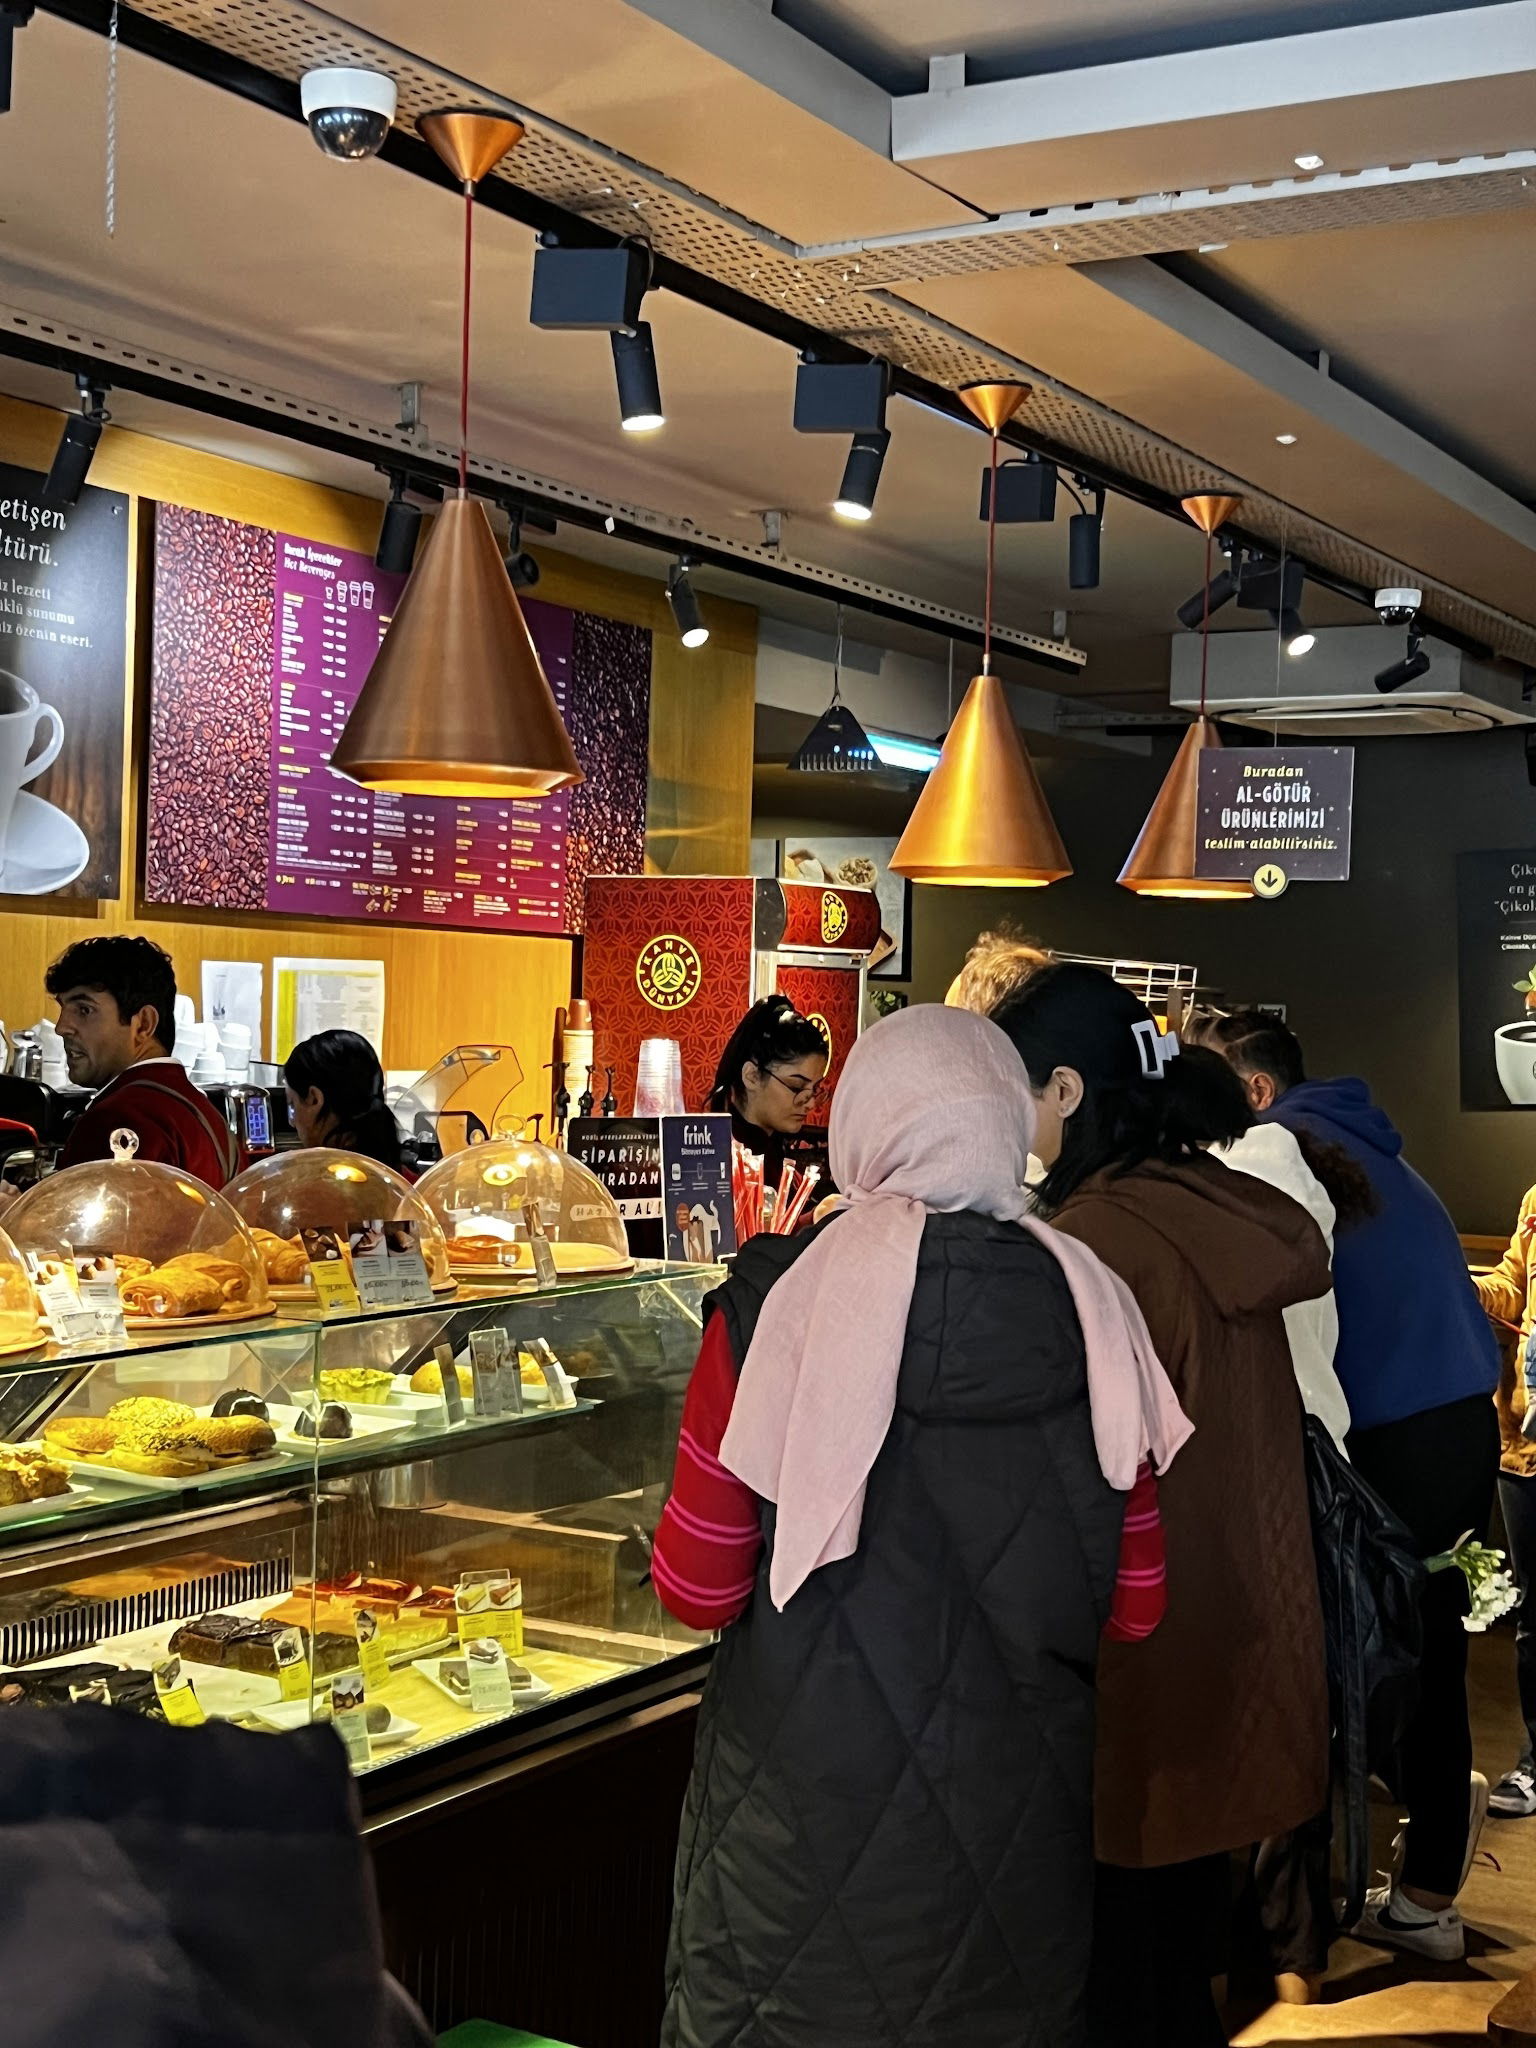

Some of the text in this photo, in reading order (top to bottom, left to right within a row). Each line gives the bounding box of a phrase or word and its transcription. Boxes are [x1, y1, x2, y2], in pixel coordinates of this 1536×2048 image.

[12, 578, 51, 601] lezzeti
[26, 606, 75, 625] sunumu
[16, 623, 57, 642] özenin
[1243, 765, 1304, 778] Buradan
[1236, 782, 1312, 804] AL-GÖTÜR
[1220, 807, 1325, 829] ÜRÜNLERİMİZİ
[1205, 837, 1338, 850] teslim alabilirsiniz.
[643, 940, 695, 967] KAHVE
[683, 1125, 712, 1145] frink
[597, 1172, 659, 1187] URADAN
